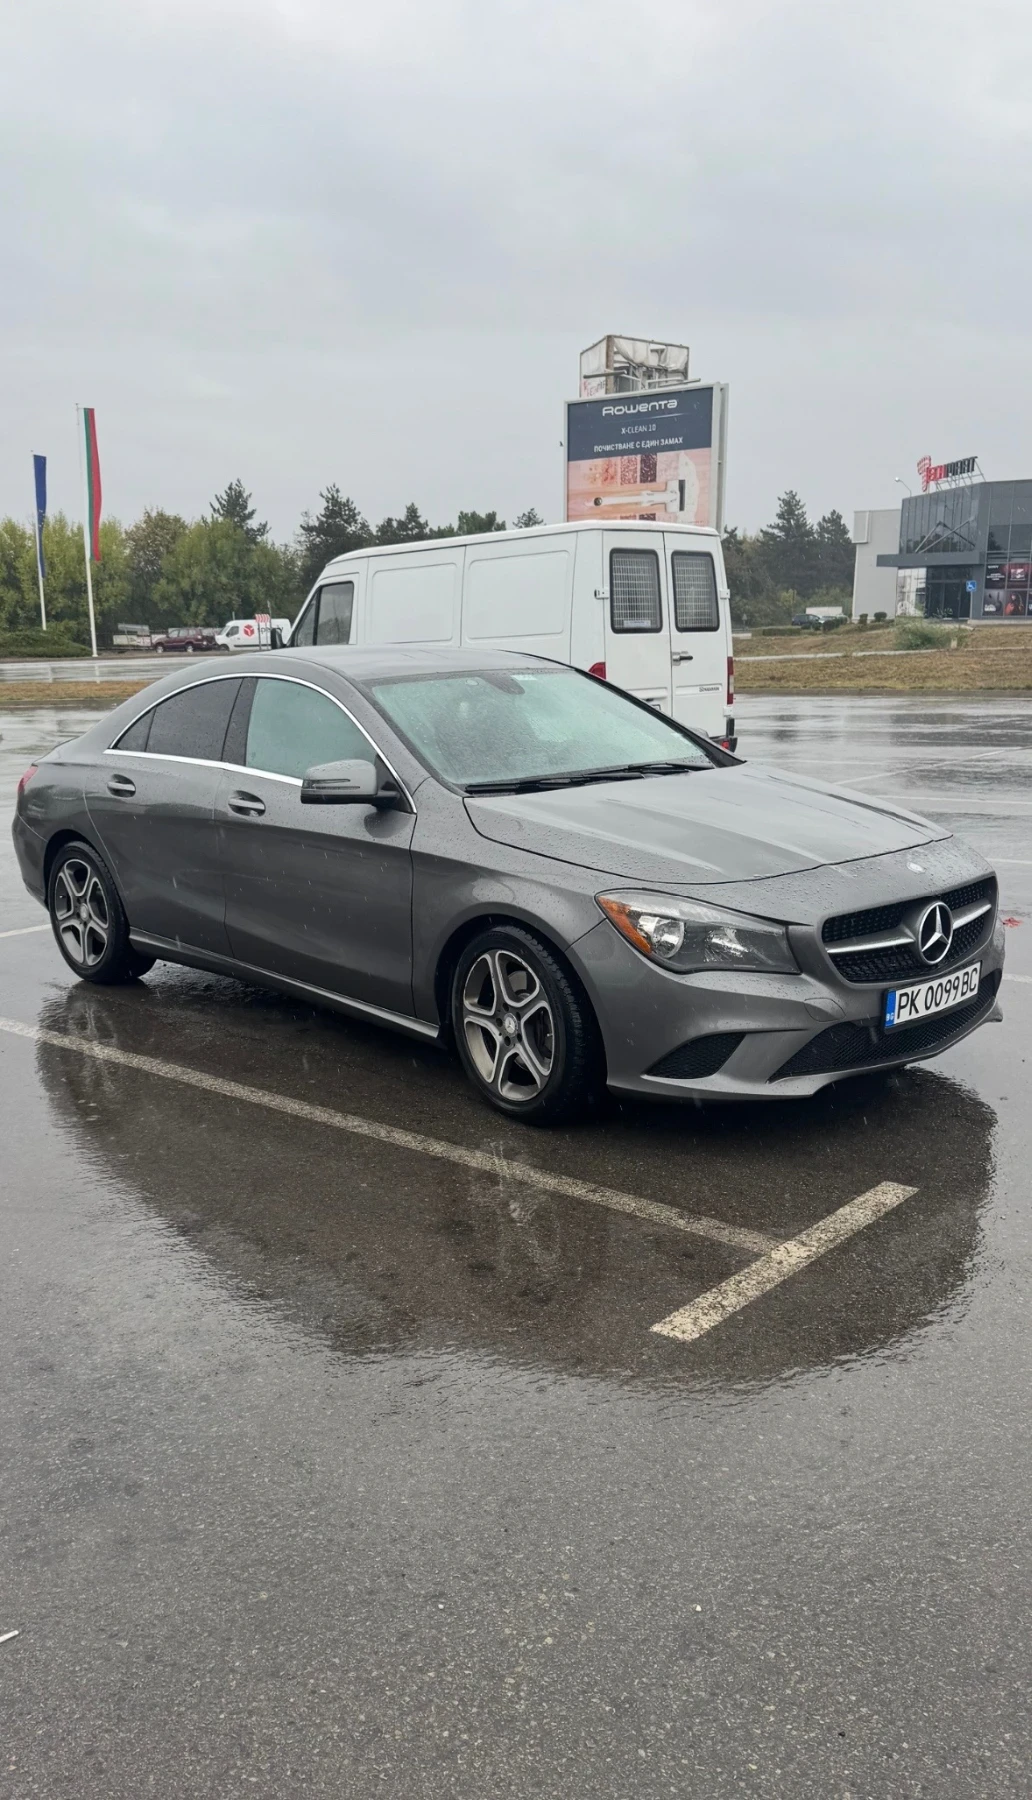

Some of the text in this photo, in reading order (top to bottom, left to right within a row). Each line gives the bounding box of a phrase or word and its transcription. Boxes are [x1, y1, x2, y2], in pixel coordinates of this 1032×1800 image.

[602, 399, 678, 416] Rowenta
[621, 424, 656, 434] X-CLEAN 10
[593, 442, 635, 452] ПОЧИСТВАНЕ
[641, 439, 659, 449] ЕДИН
[660, 436, 683, 446] ЗАМАХ
[897, 967, 978, 1019] PK 0099 BC
